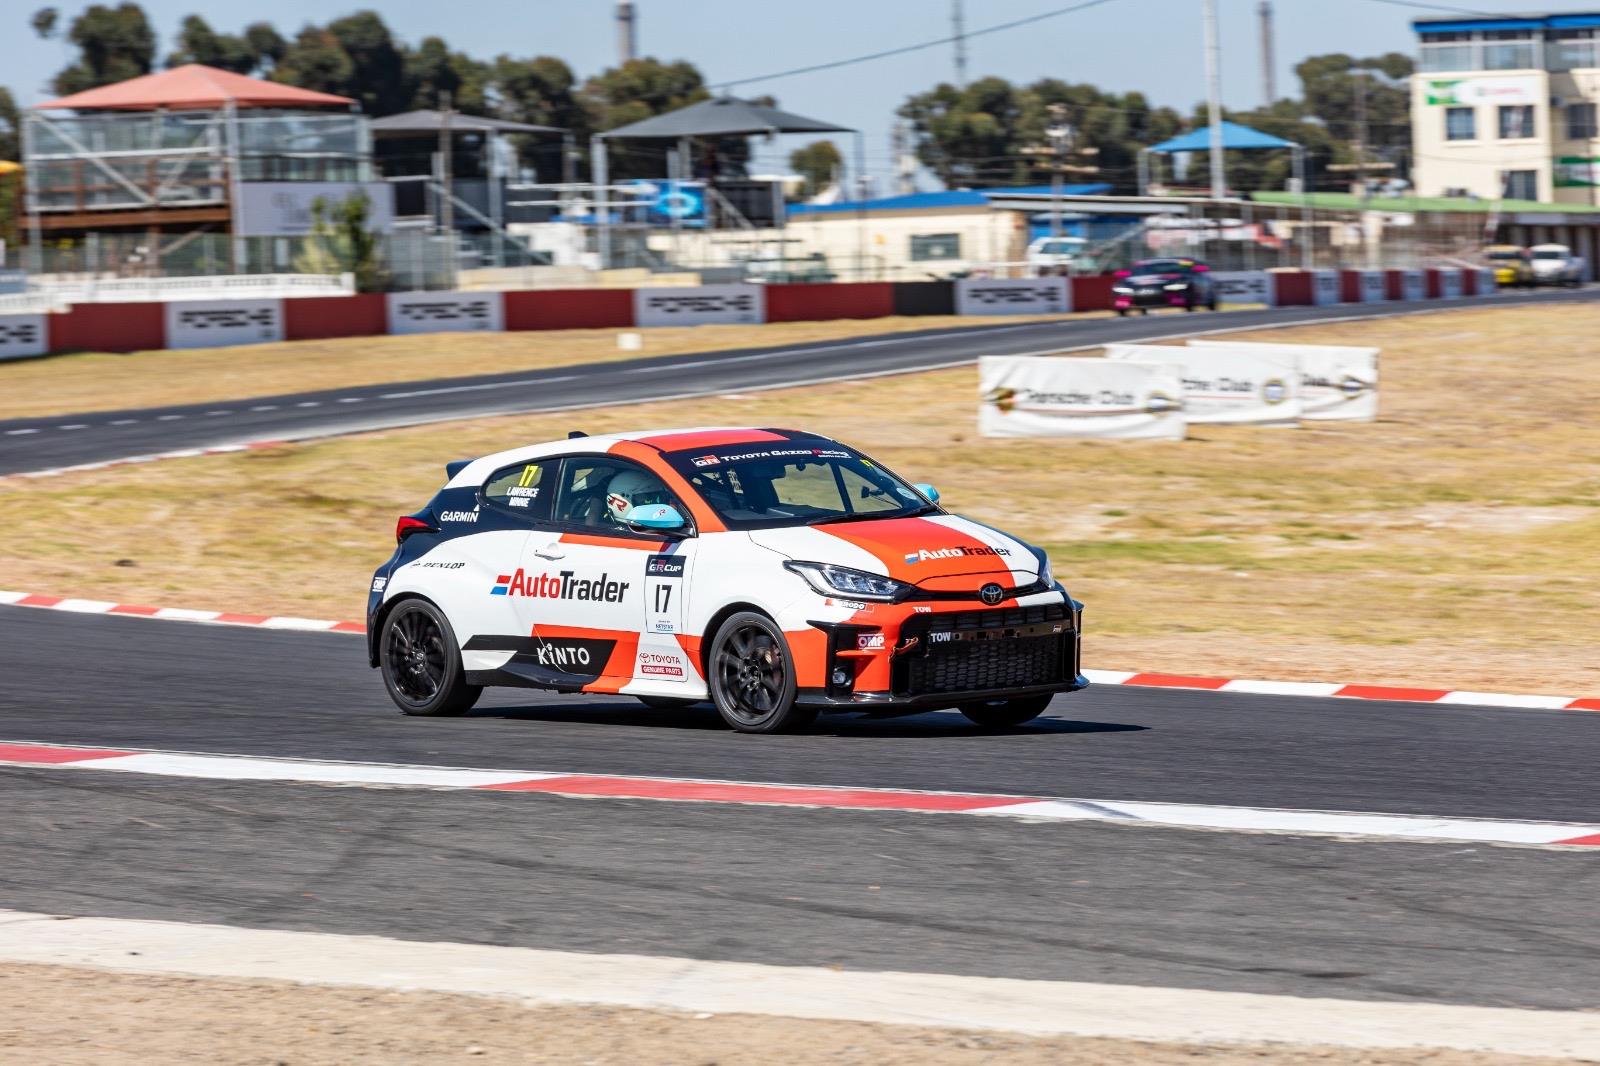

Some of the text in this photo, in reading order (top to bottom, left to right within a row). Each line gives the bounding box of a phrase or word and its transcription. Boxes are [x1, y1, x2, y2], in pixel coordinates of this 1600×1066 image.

[721, 452, 770, 462] TOYOTA
[518, 465, 539, 487] 17
[506, 486, 539, 498] LAWRENCE
[440, 510, 479, 523] GARMIN
[918, 546, 1012, 561] AutoTrader
[423, 562, 466, 570] DUNLOP
[508, 567, 630, 603] AutoTrader
[655, 584, 673, 614] 17
[858, 635, 885, 648] OMP
[930, 631, 952, 643] TOW
[651, 654, 681, 665] TOYOTA
[665, 667, 682, 675] PARTS
